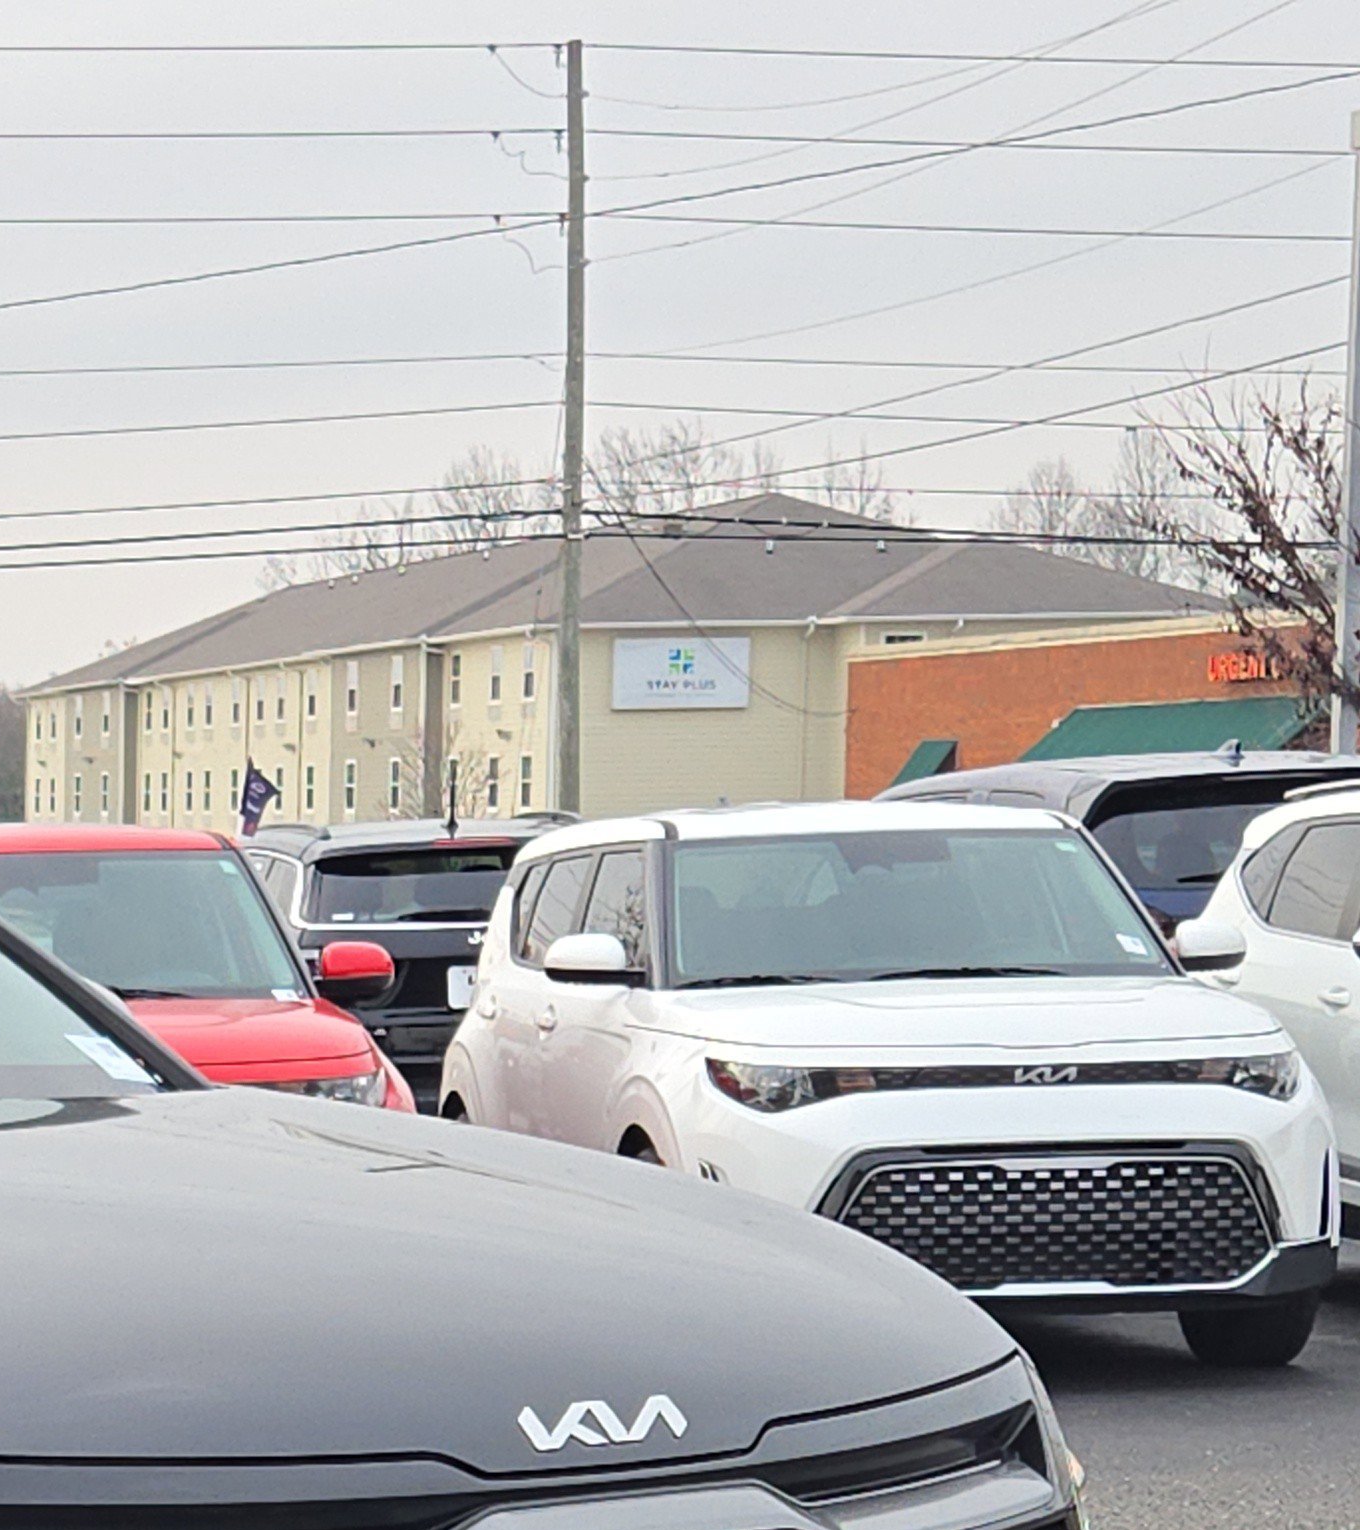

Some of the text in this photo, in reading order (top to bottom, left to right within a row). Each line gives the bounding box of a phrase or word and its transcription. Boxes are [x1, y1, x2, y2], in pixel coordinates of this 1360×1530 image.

[646, 679, 716, 690] STAY PLUS
[1014, 1066, 1078, 1083] KIA
[517, 1394, 688, 1451] KIA
